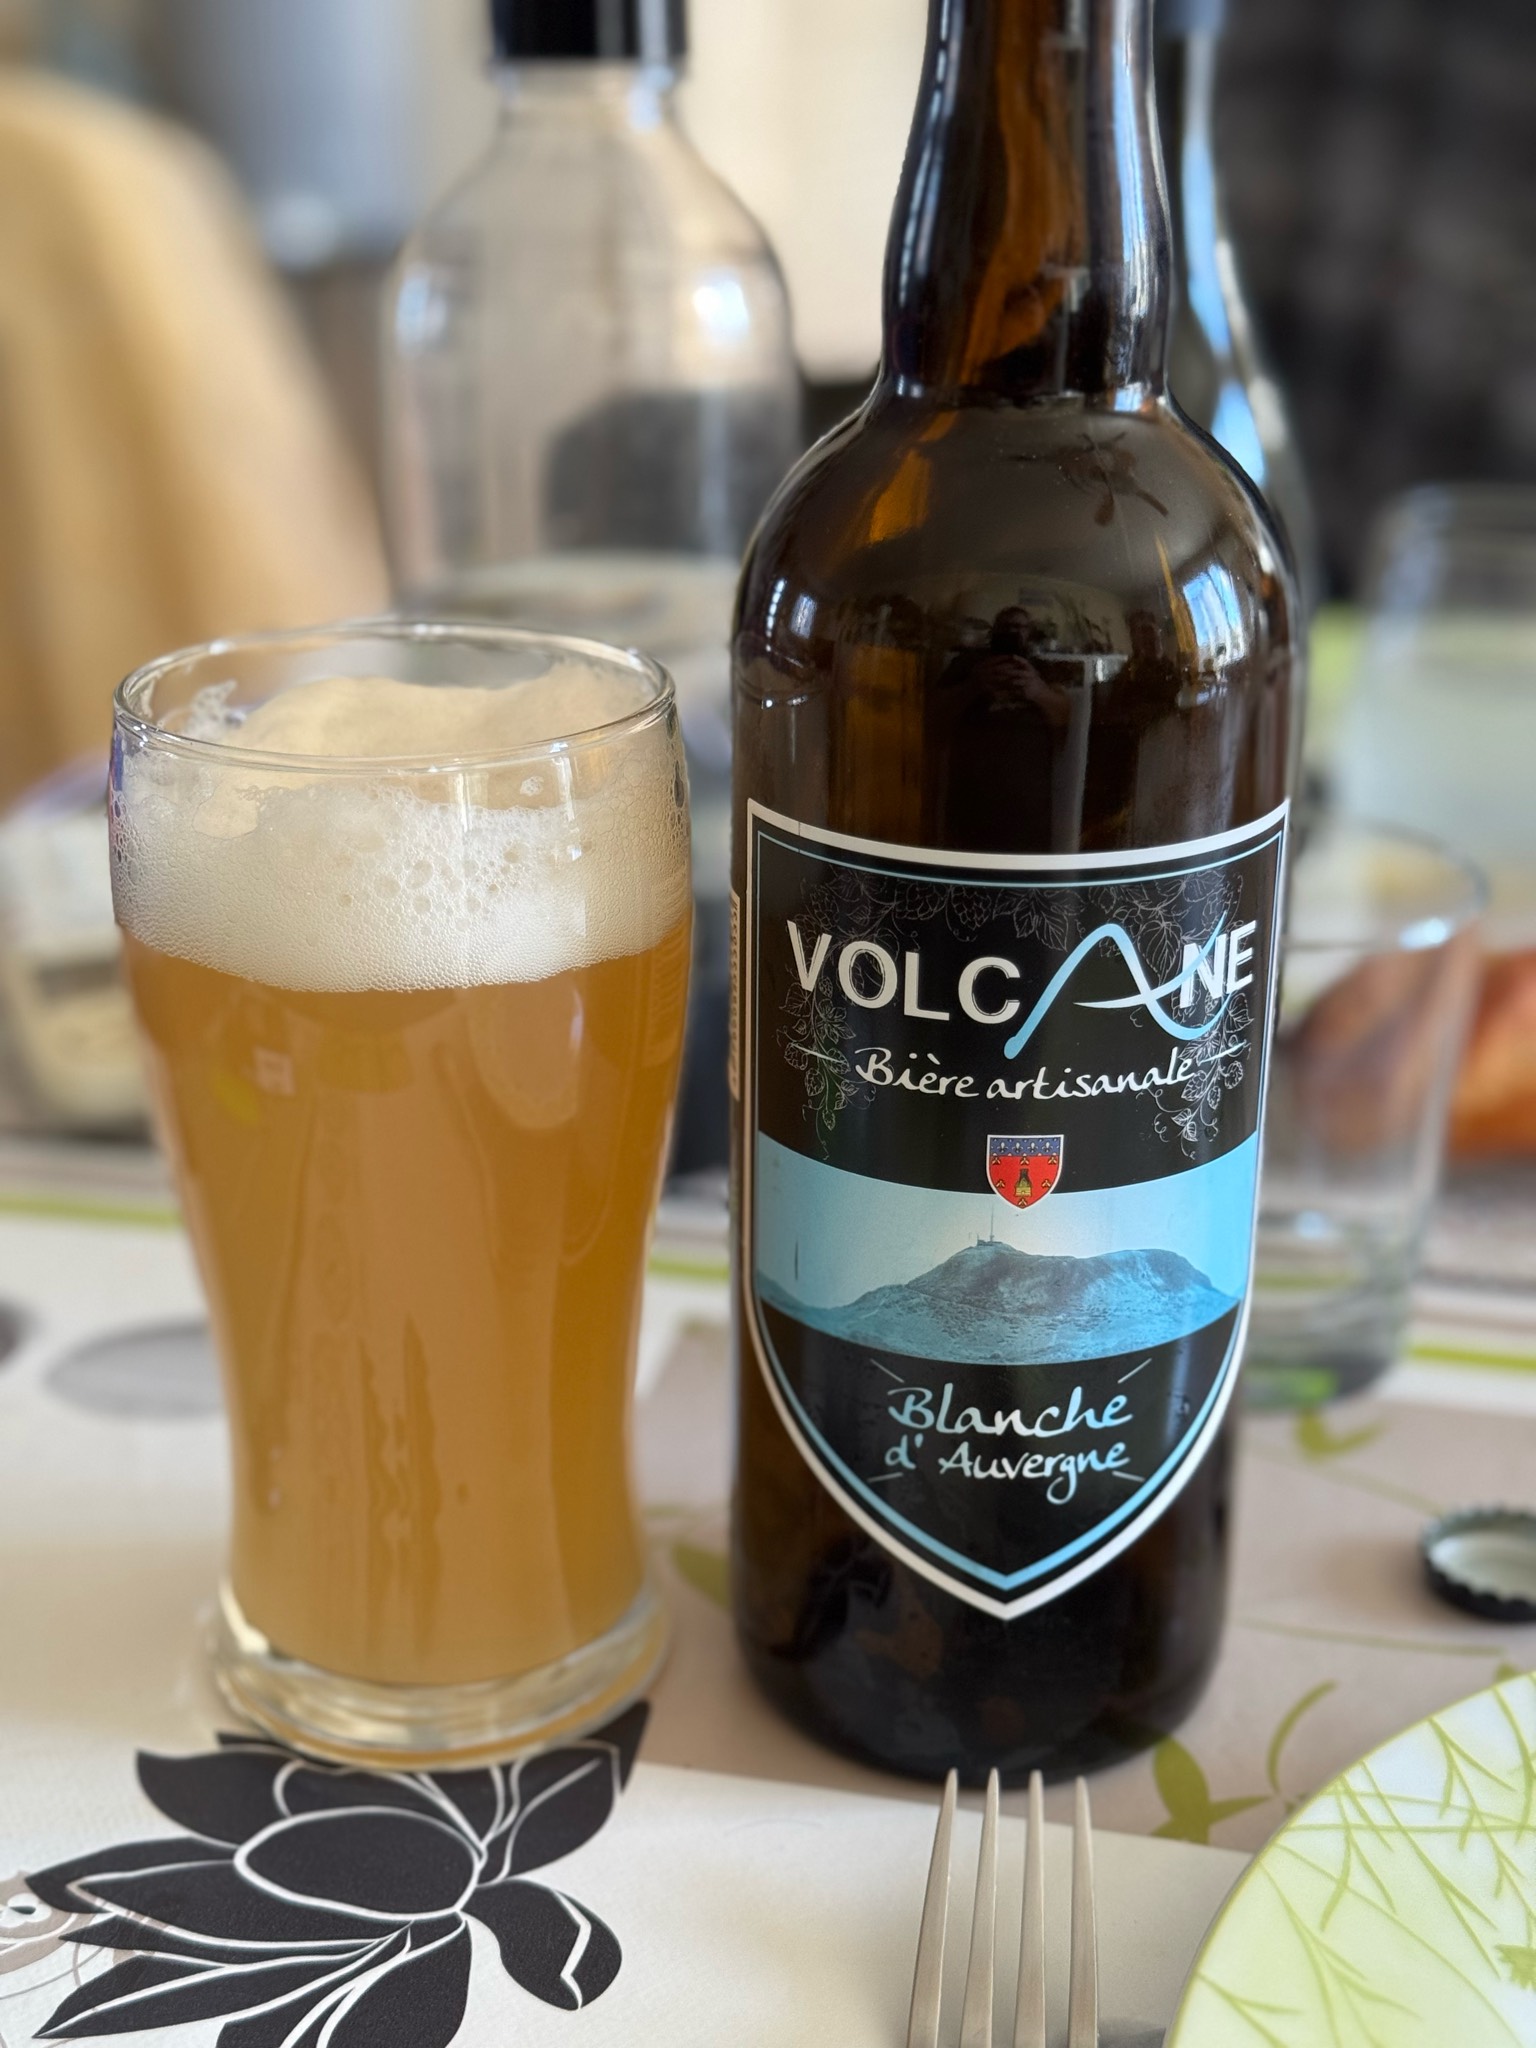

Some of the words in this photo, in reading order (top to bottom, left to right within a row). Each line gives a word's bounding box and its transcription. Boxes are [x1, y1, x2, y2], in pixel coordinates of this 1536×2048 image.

[786, 911, 1257, 1059] VOLCANE
[855, 1046, 980, 1098] Bière
[986, 1046, 1196, 1101] artisanale
[887, 1383, 1133, 1438] Blanche
[938, 1441, 1130, 1504] Auvergne
